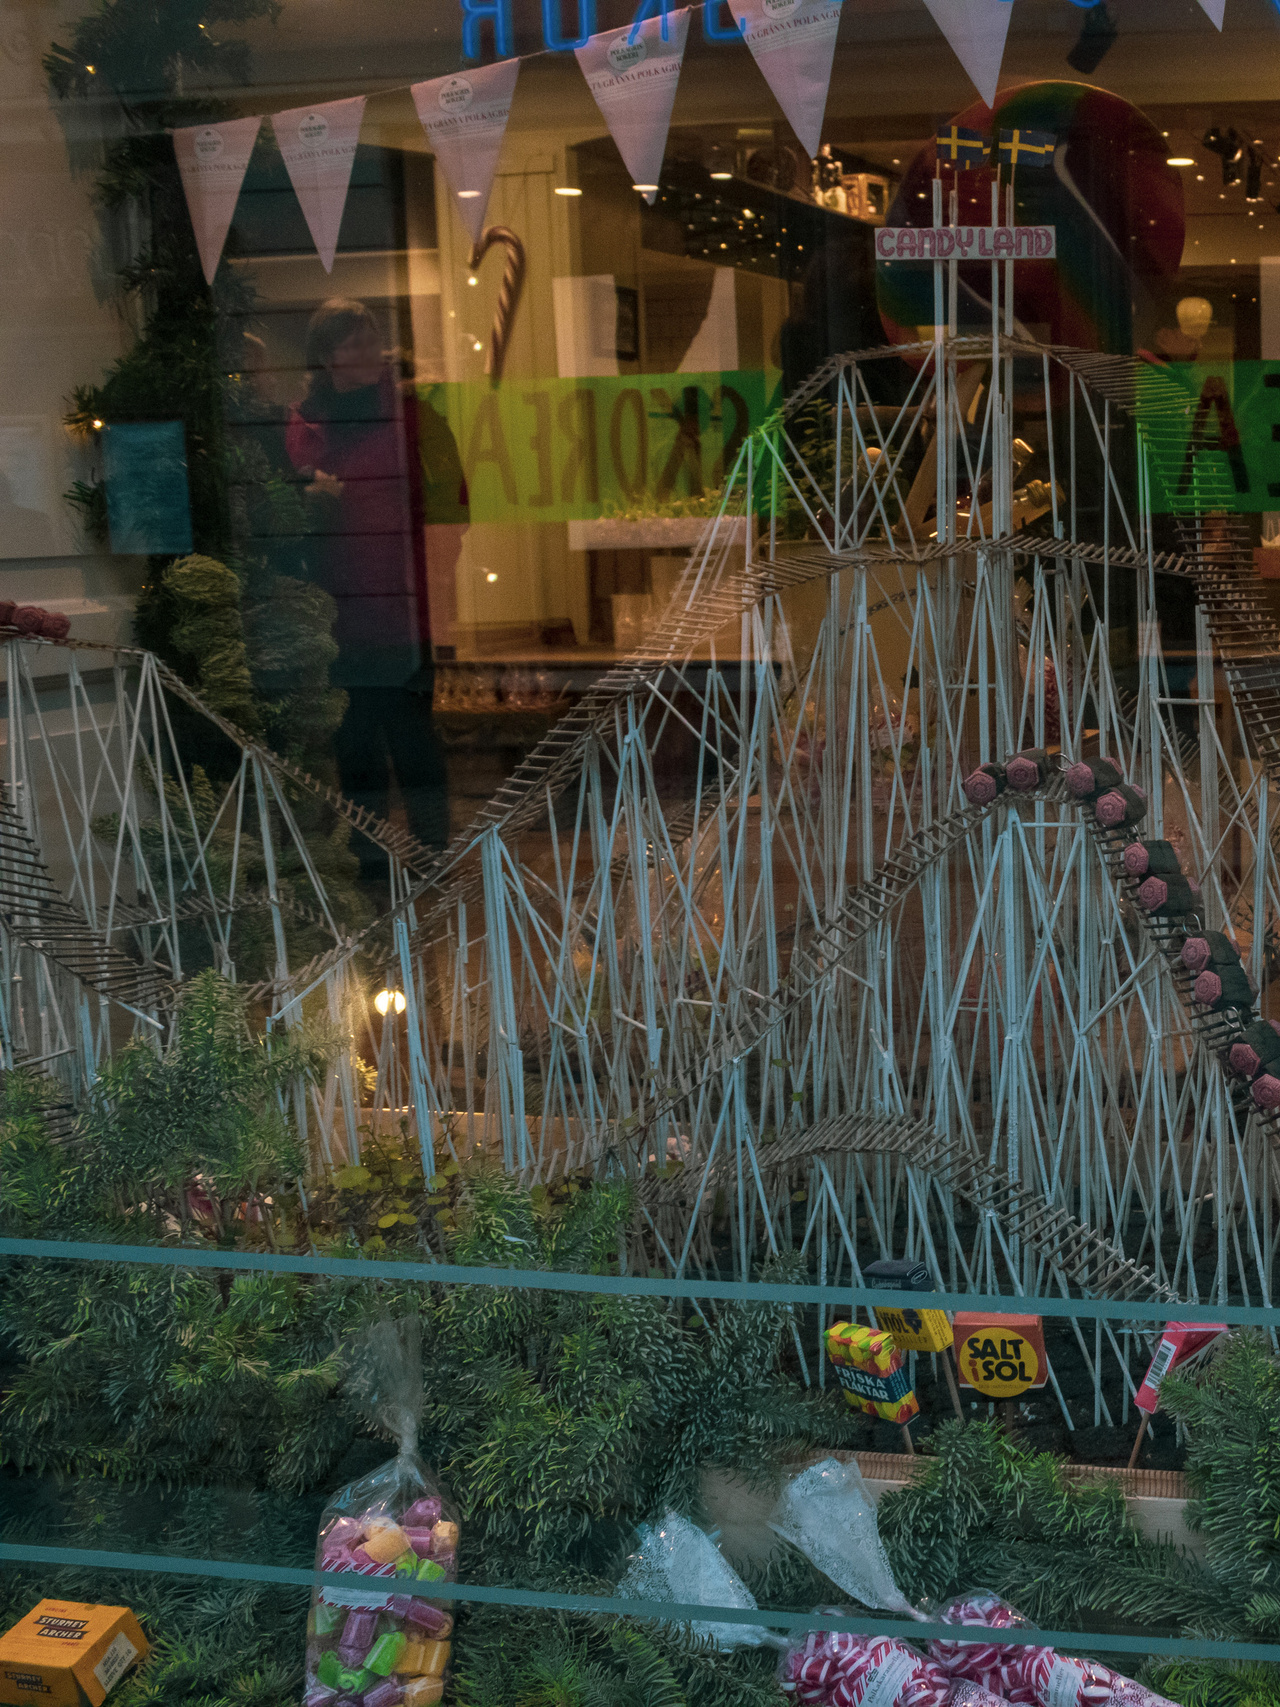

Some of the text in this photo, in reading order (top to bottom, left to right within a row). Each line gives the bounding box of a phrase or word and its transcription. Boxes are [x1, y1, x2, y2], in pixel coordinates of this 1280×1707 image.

[877, 227, 1053, 257] CANDY LAND
[967, 1337, 1024, 1360] SALT
[834, 1365, 886, 1389] FRISKA
[968, 1359, 1033, 1382] i SOL
[39, 1616, 87, 1629] STURMEY
[40, 1628, 82, 1639] ARCHER
